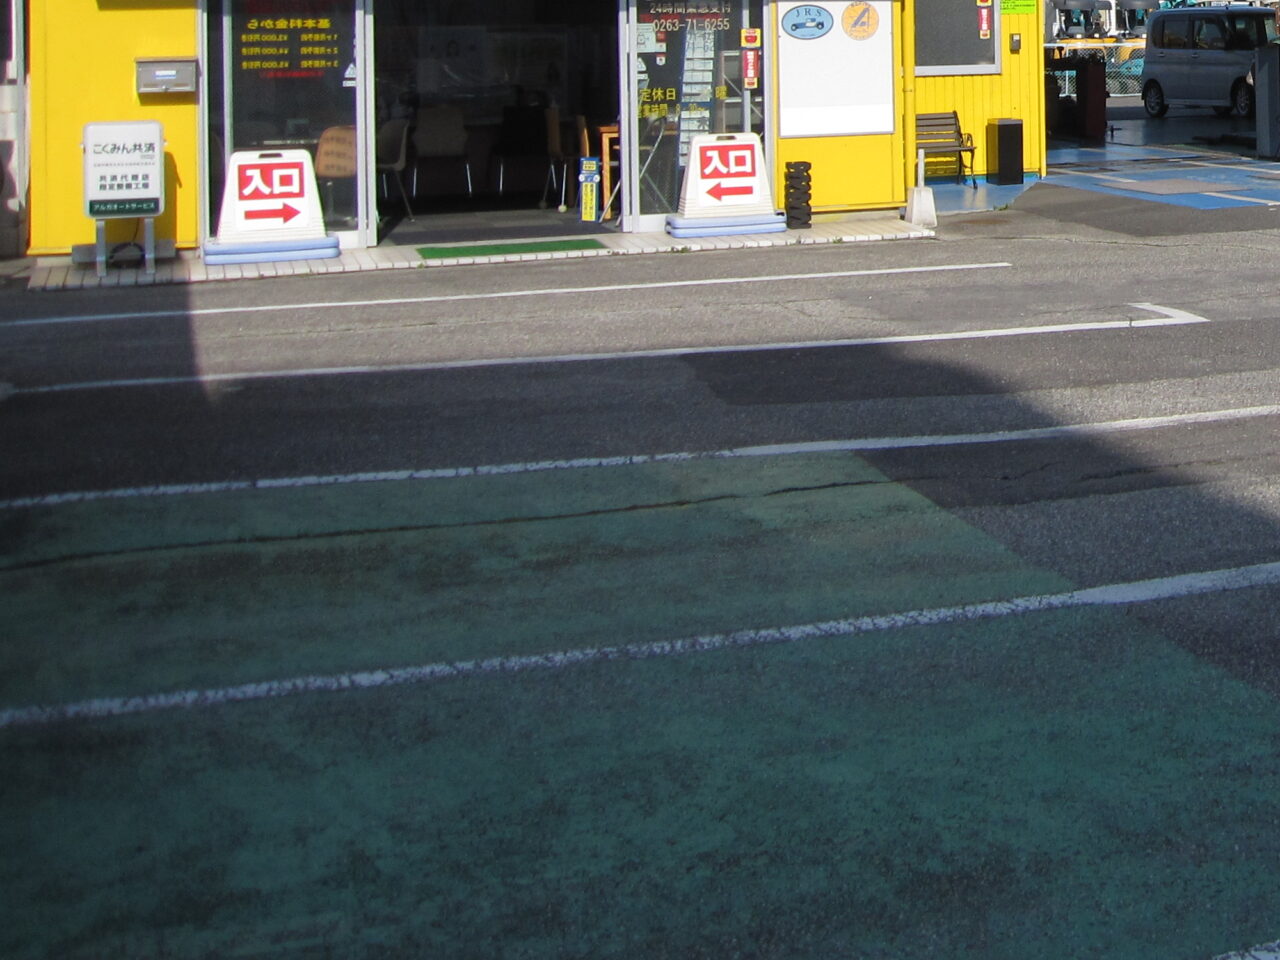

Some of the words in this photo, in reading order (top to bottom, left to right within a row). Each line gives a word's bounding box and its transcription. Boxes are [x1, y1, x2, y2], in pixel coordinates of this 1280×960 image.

[653, 18, 730, 31] 0263-71-6255
[640, 88, 676, 101] 定休日
[93, 143, 156, 155] こくみん共済
[703, 147, 753, 177] 入口
[242, 167, 302, 196] 入口
